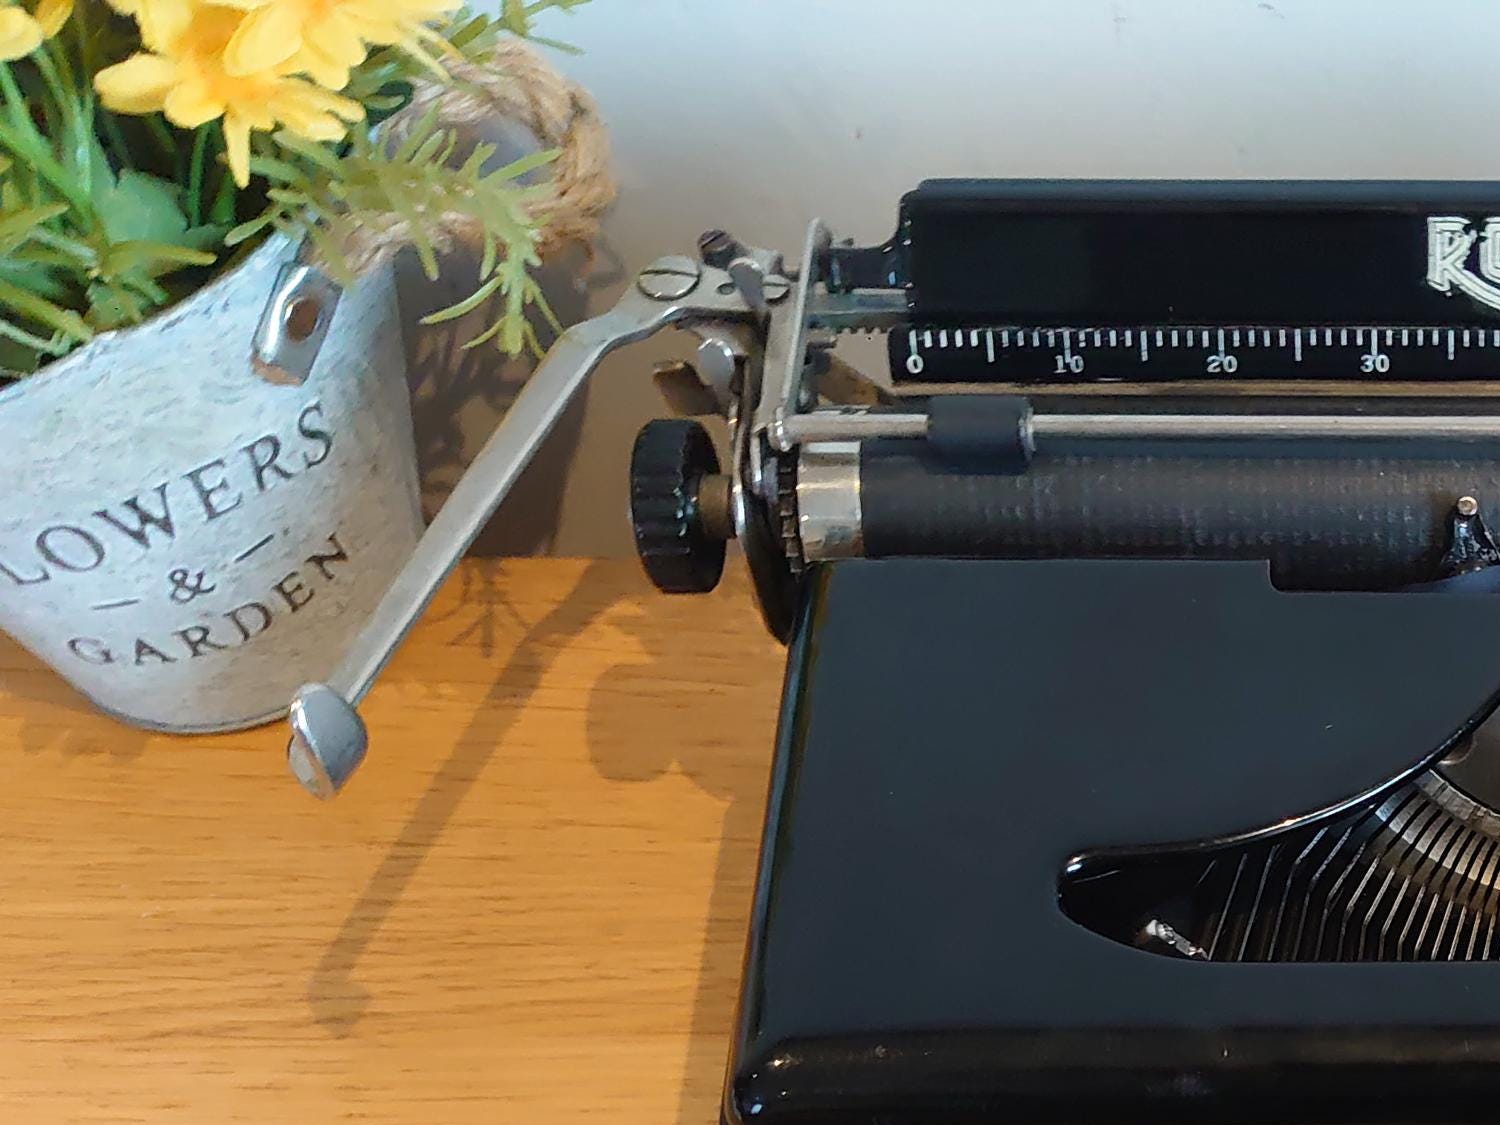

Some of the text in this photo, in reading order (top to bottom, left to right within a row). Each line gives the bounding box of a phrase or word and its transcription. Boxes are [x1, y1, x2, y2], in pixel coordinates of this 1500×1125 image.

[907, 354, 923, 374] 0
[1054, 354, 1084, 374] 10
[1207, 354, 1237, 373] 20
[1361, 354, 1389, 373] 30
[67, 531, 349, 667] GARDEN
[168, 568, 217, 604] &
